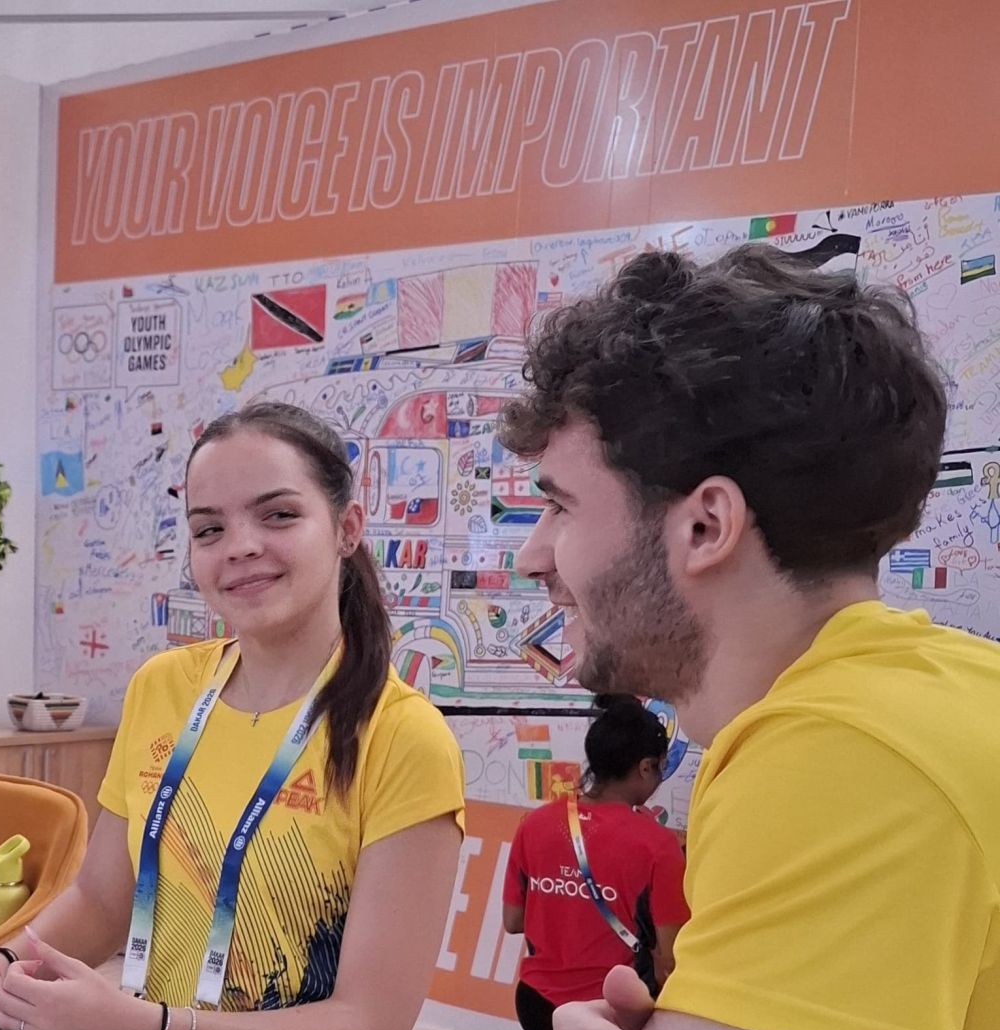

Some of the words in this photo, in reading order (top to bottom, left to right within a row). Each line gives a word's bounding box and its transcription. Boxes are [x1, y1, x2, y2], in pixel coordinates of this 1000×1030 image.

[72, 112, 197, 245] YOUR
[197, 83, 361, 231] VOICE
[348, 70, 423, 210] IS
[414, 0, 852, 205] IMPORTANT
[925, 254, 953, 275] here
[131, 314, 167, 334] YOUTH
[123, 333, 173, 353] OLYMPIC
[127, 353, 167, 373] GAMES
[915, 509, 963, 539] makes
[933, 522, 975, 548] family
[366, 539, 429, 569] AKAR
[149, 800, 166, 839] Allianz
[241, 797, 266, 835] Allianz
[530, 876, 618, 902] MOROCO
